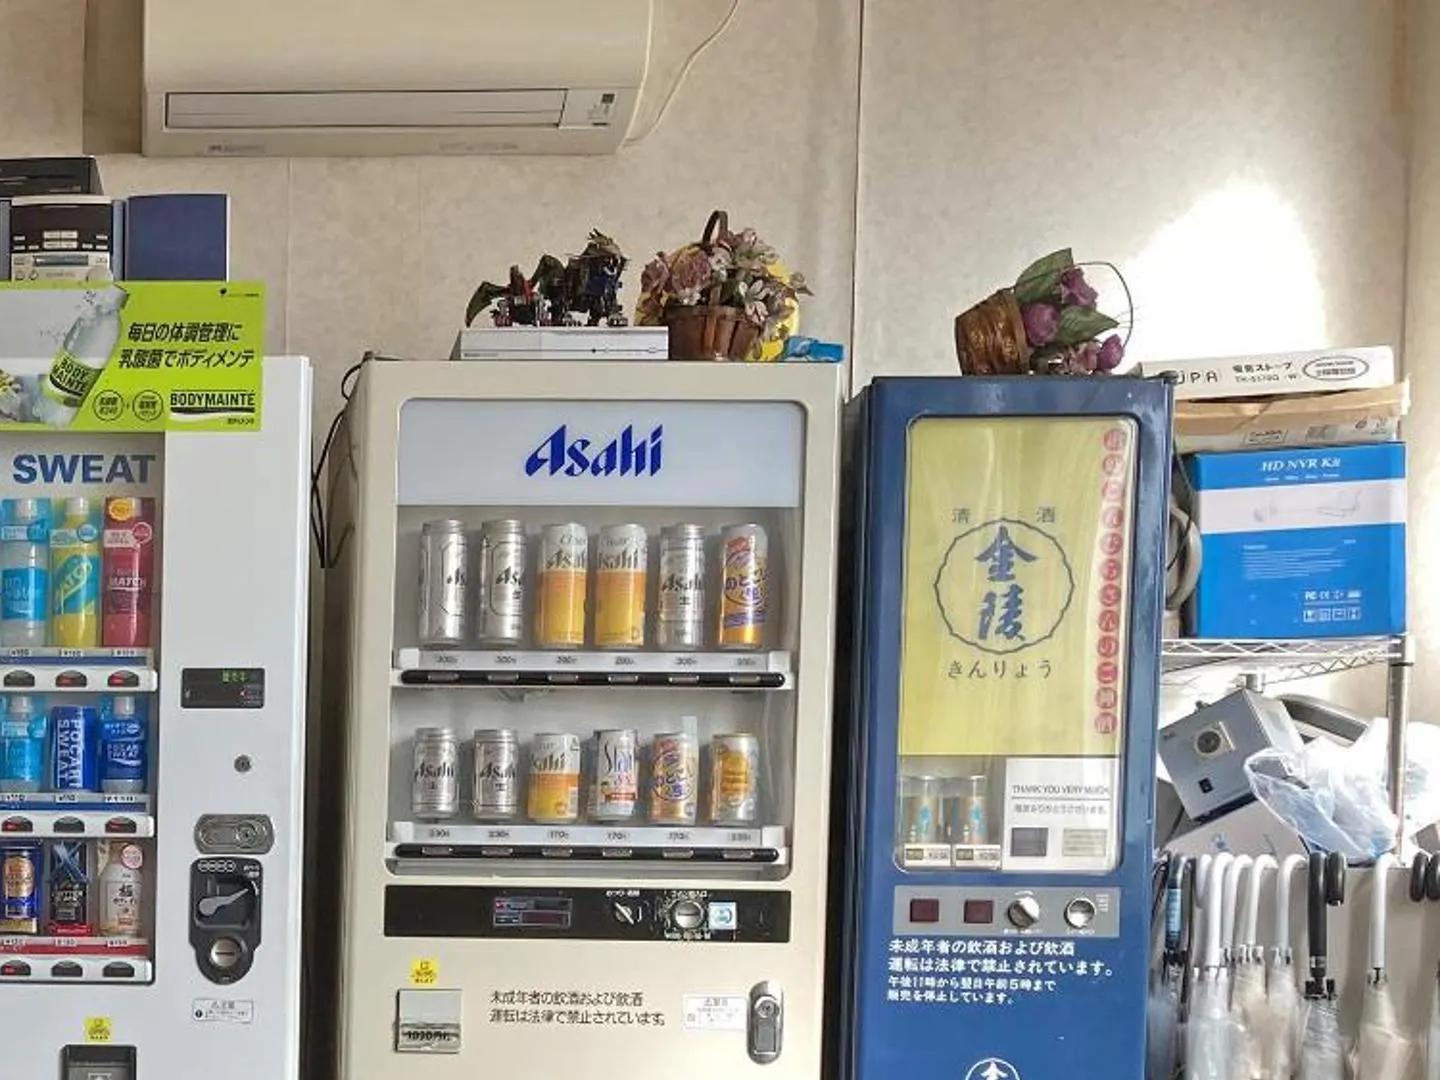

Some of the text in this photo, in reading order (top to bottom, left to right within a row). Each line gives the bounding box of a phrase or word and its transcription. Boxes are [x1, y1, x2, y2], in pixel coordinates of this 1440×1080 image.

[128, 322, 243, 342] 毎日の体調管理に
[118, 349, 255, 369] 乳酸菌でボディメンテ
[525, 424, 663, 477] Asahi
[12, 454, 156, 484] SWEAT
[1262, 460, 1284, 472] HD
[1287, 459, 1318, 470] NVR
[951, 507, 970, 524] 清
[1036, 507, 1056, 524] 酒
[947, 659, 1053, 681] きんりょう
[69, 719, 83, 789] POCARI
[1012, 785, 1042, 795] THANK
[1044, 785, 1061, 795] YOU
[1062, 786, 1084, 795] VERY
[888, 939, 1075, 957] 未成年者の飲酒および飲酒
[888, 957, 1112, 977] 運転は法律で禁止されています。
[887, 976, 1057, 992] 午後11時から翌日午前5時まで
[490, 989, 644, 1008] 未成年者の飲酒および飲酒
[887, 990, 1015, 1005] 販売を停止しています。
[489, 1008, 666, 1027] 運転は法律で禁止されています。
